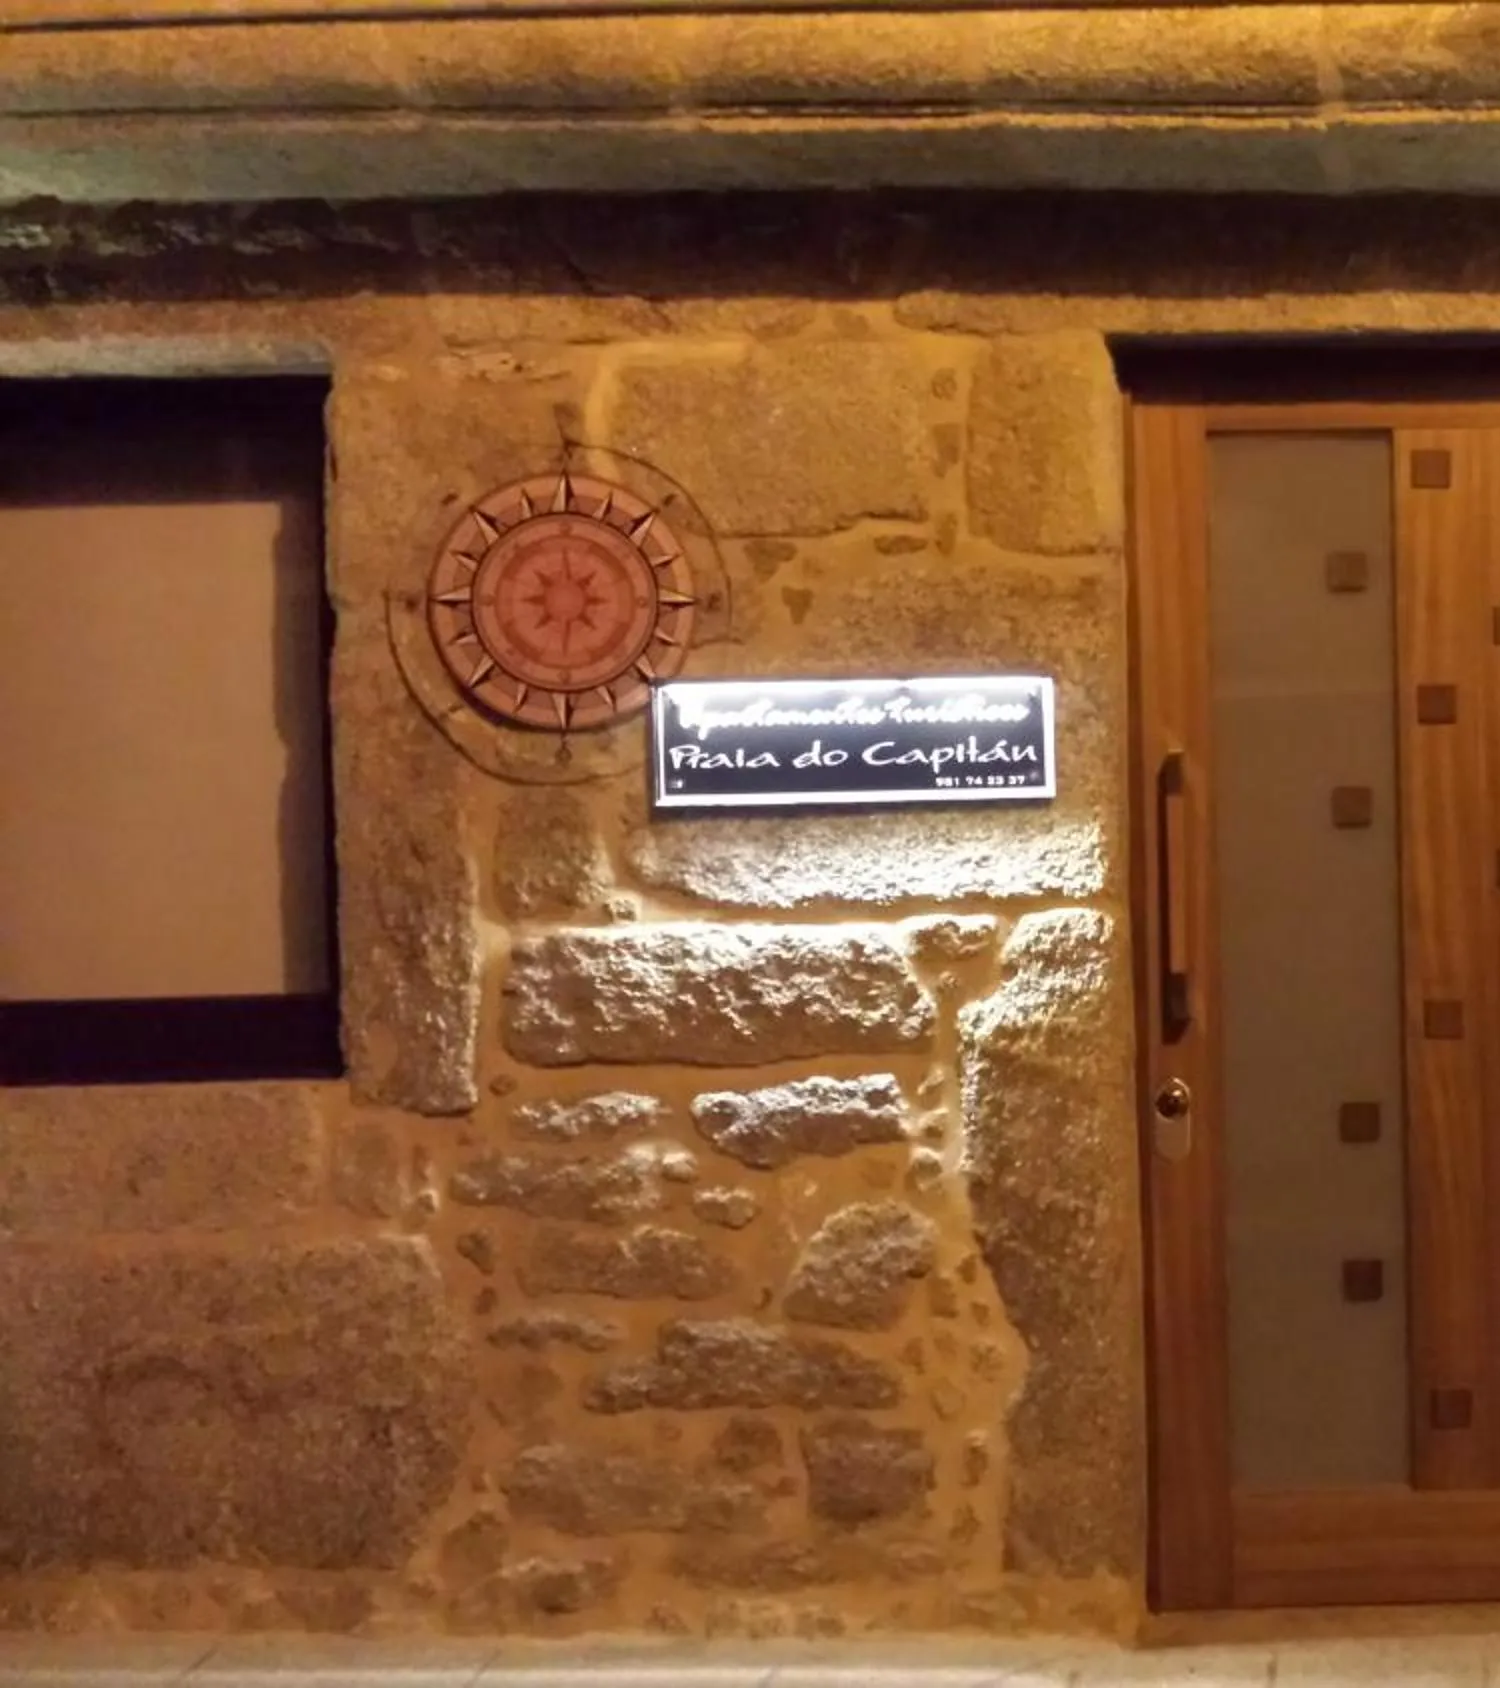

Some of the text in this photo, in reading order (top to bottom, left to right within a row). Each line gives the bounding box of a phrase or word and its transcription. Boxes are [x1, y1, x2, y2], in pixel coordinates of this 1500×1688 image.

[669, 735, 1038, 774] Praia do Capitán
